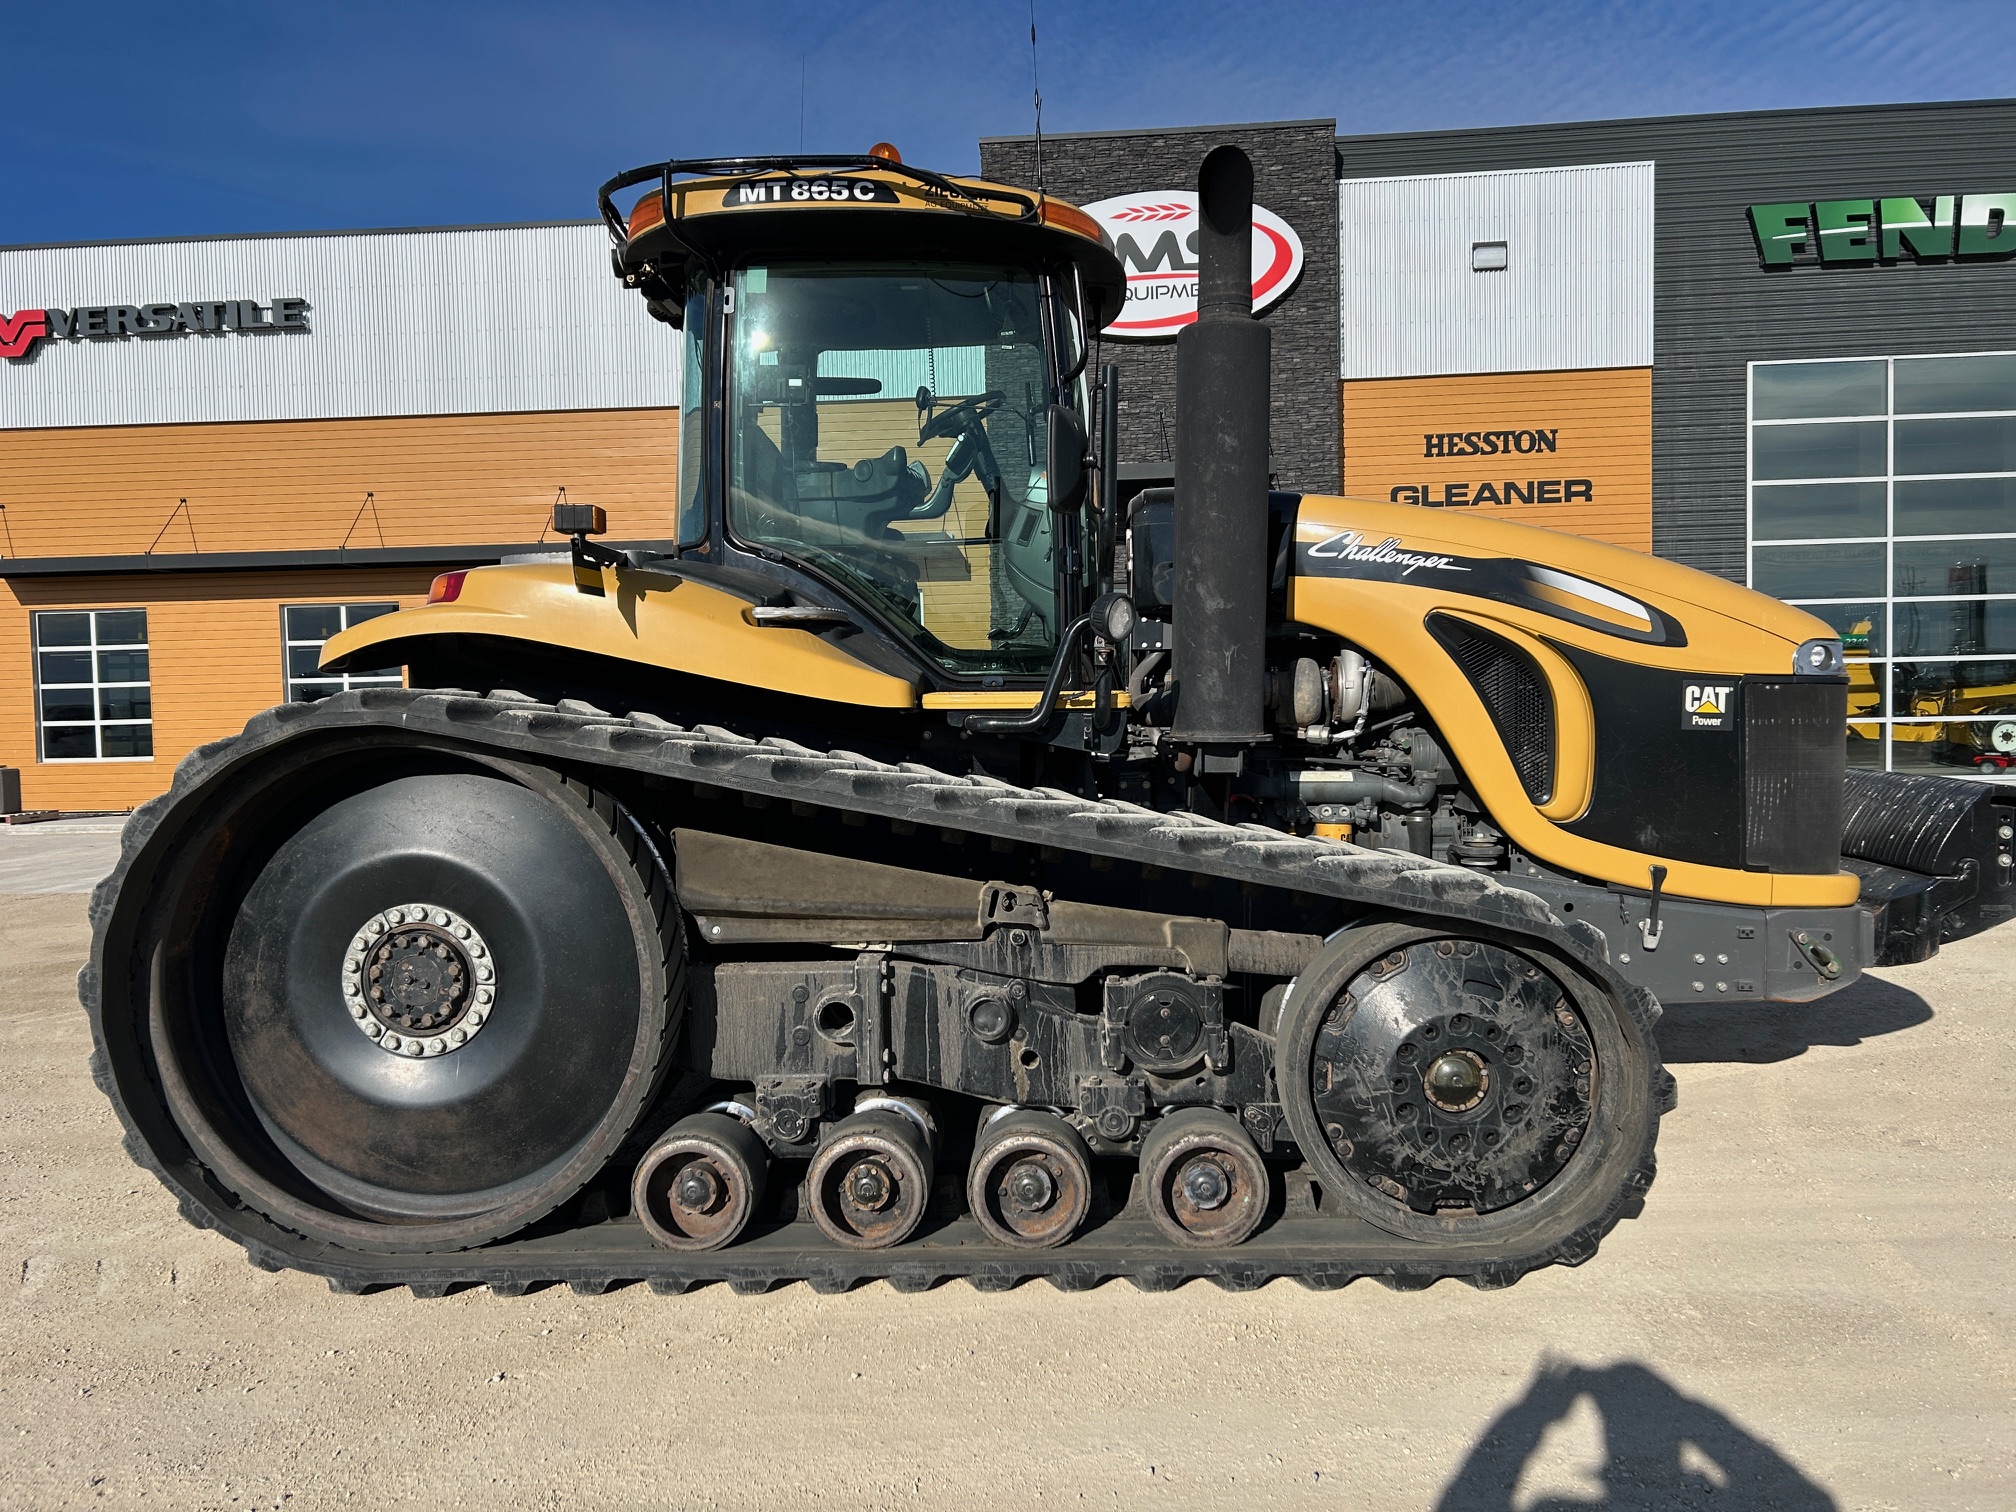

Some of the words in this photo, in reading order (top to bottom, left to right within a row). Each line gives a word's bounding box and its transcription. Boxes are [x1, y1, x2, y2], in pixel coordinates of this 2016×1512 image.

[1750, 192, 2016, 265] FEND
[47, 297, 306, 337] VERSATILE
[1423, 428, 1559, 458] HESSTON
[1389, 478, 1593, 508] GLEANER
[1307, 529, 1472, 576] Challenger
[1685, 685, 1730, 714] CAT
[1692, 715, 1722, 726] Power
